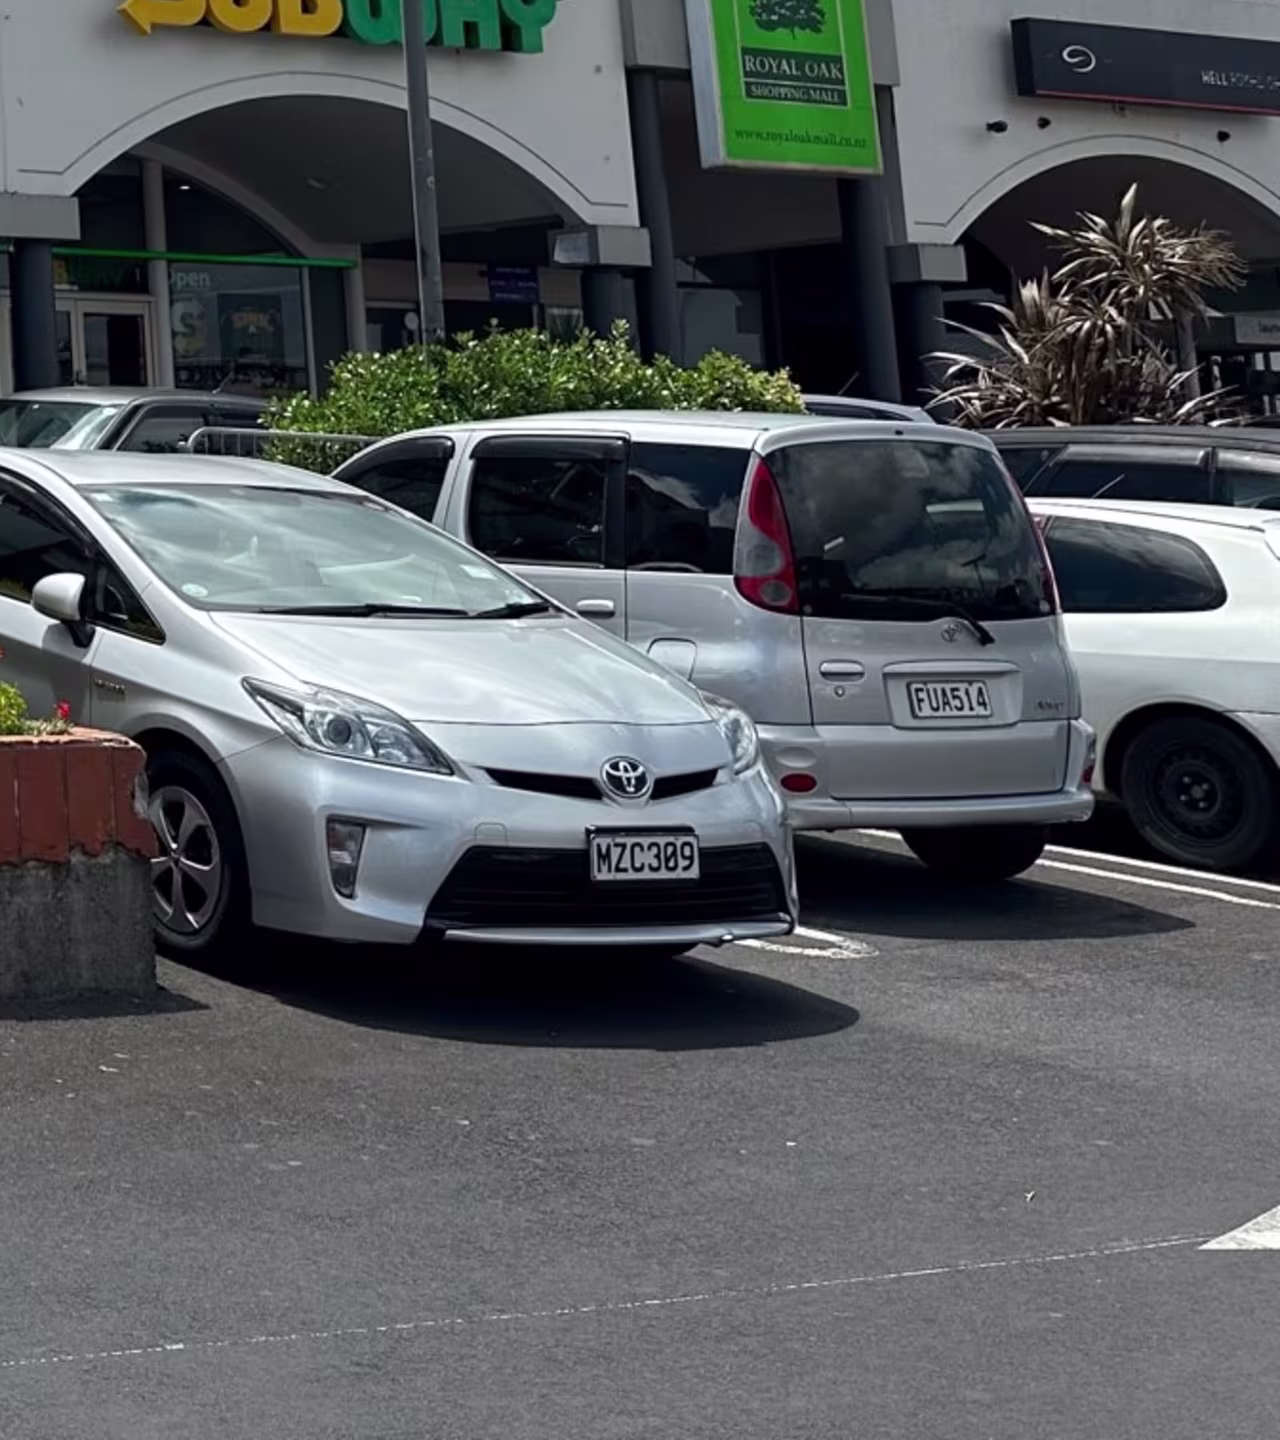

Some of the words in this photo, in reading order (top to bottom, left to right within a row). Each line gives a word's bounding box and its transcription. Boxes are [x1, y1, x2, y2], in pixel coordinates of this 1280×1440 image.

[744, 55, 800, 76] ROYAL
[805, 61, 843, 80] OAK
[750, 84, 808, 100] SHOPPING
[809, 89, 840, 103] MALL
[914, 685, 989, 712] FUA514
[596, 841, 694, 873] MZC309
